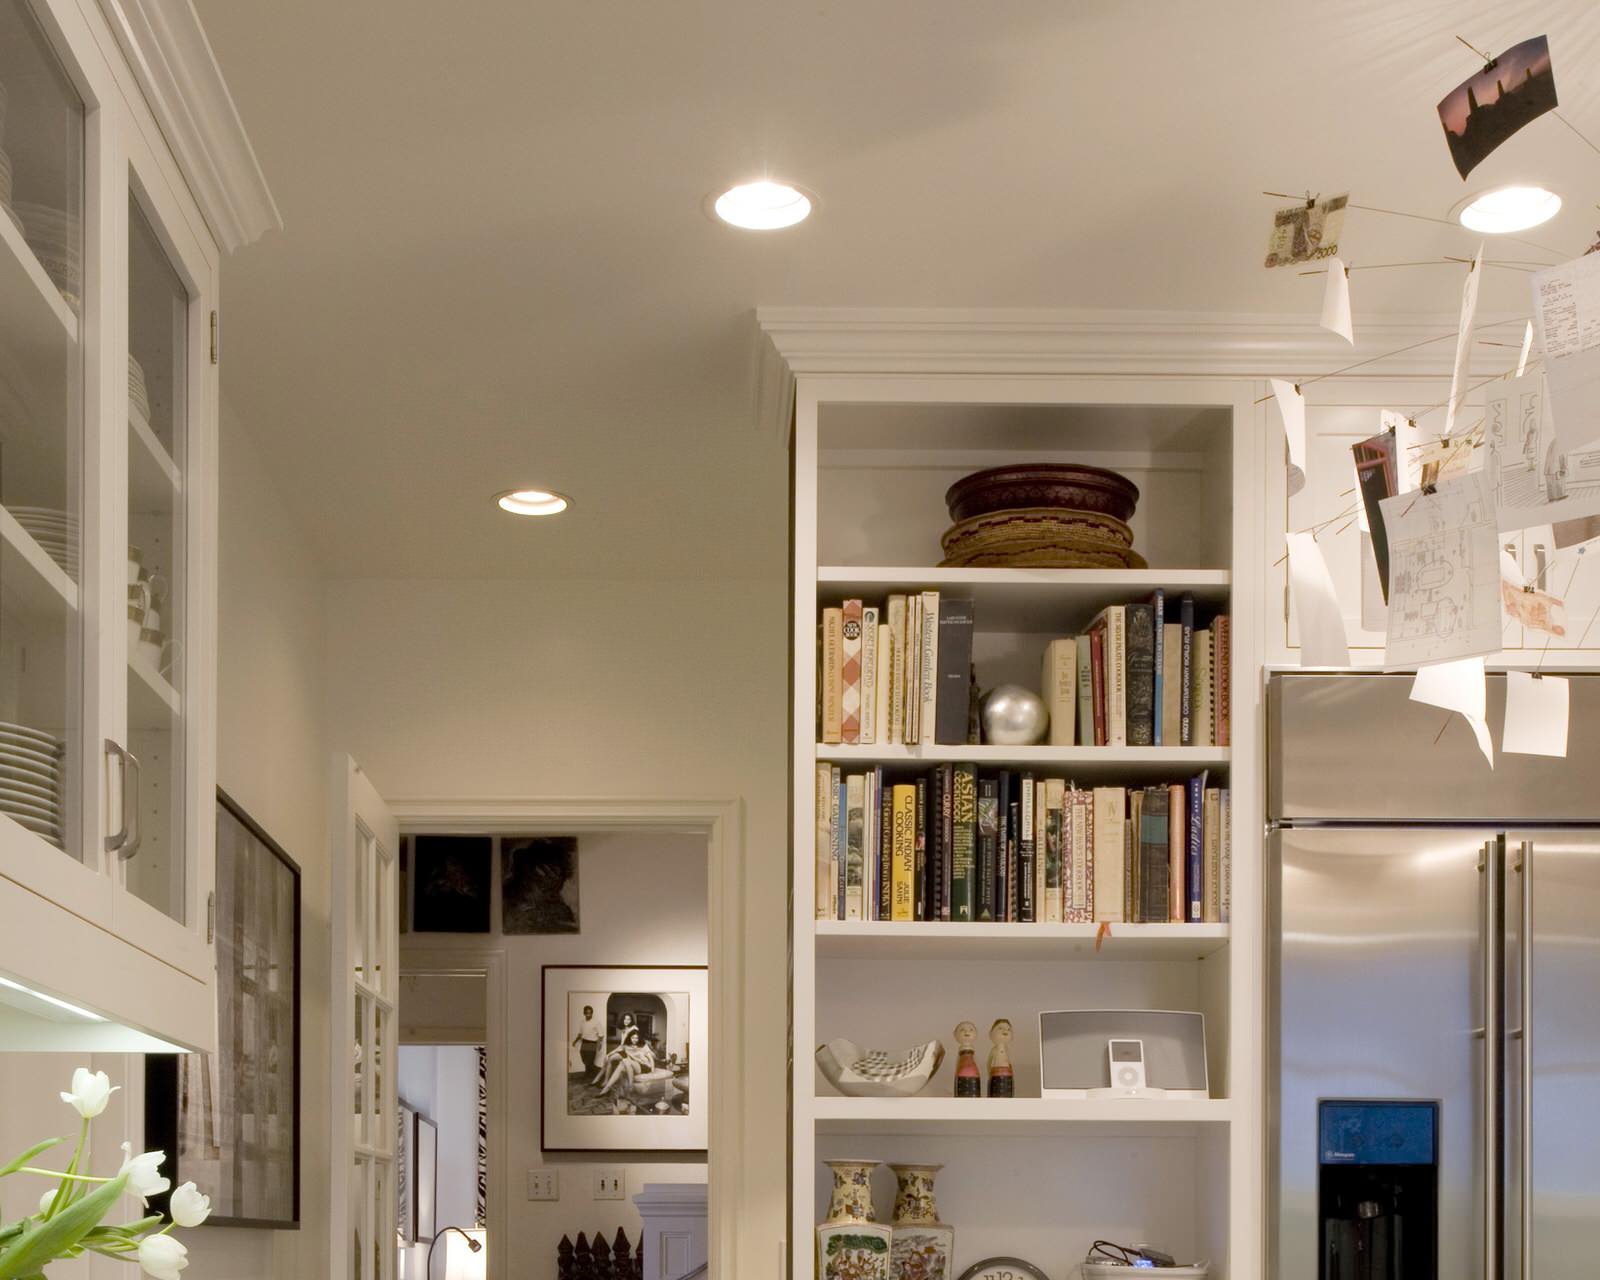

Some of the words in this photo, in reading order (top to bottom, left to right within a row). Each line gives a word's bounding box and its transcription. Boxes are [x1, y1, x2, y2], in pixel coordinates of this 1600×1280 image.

[924, 611, 935, 647] Western
[923, 648, 934, 681] Garden
[923, 682, 933, 704] Book
[953, 771, 961, 823] COOKBOOK
[961, 772, 973, 823] ASIAN
[904, 795, 914, 835] CLASSIC
[881, 830, 890, 862] Cooking
[895, 811, 904, 857] COOKING
[1191, 814, 1201, 856] Ladies
[903, 838, 913, 872] INDIAN
[882, 881, 890, 906] INDIA
[896, 881, 904, 905] SAHNI
